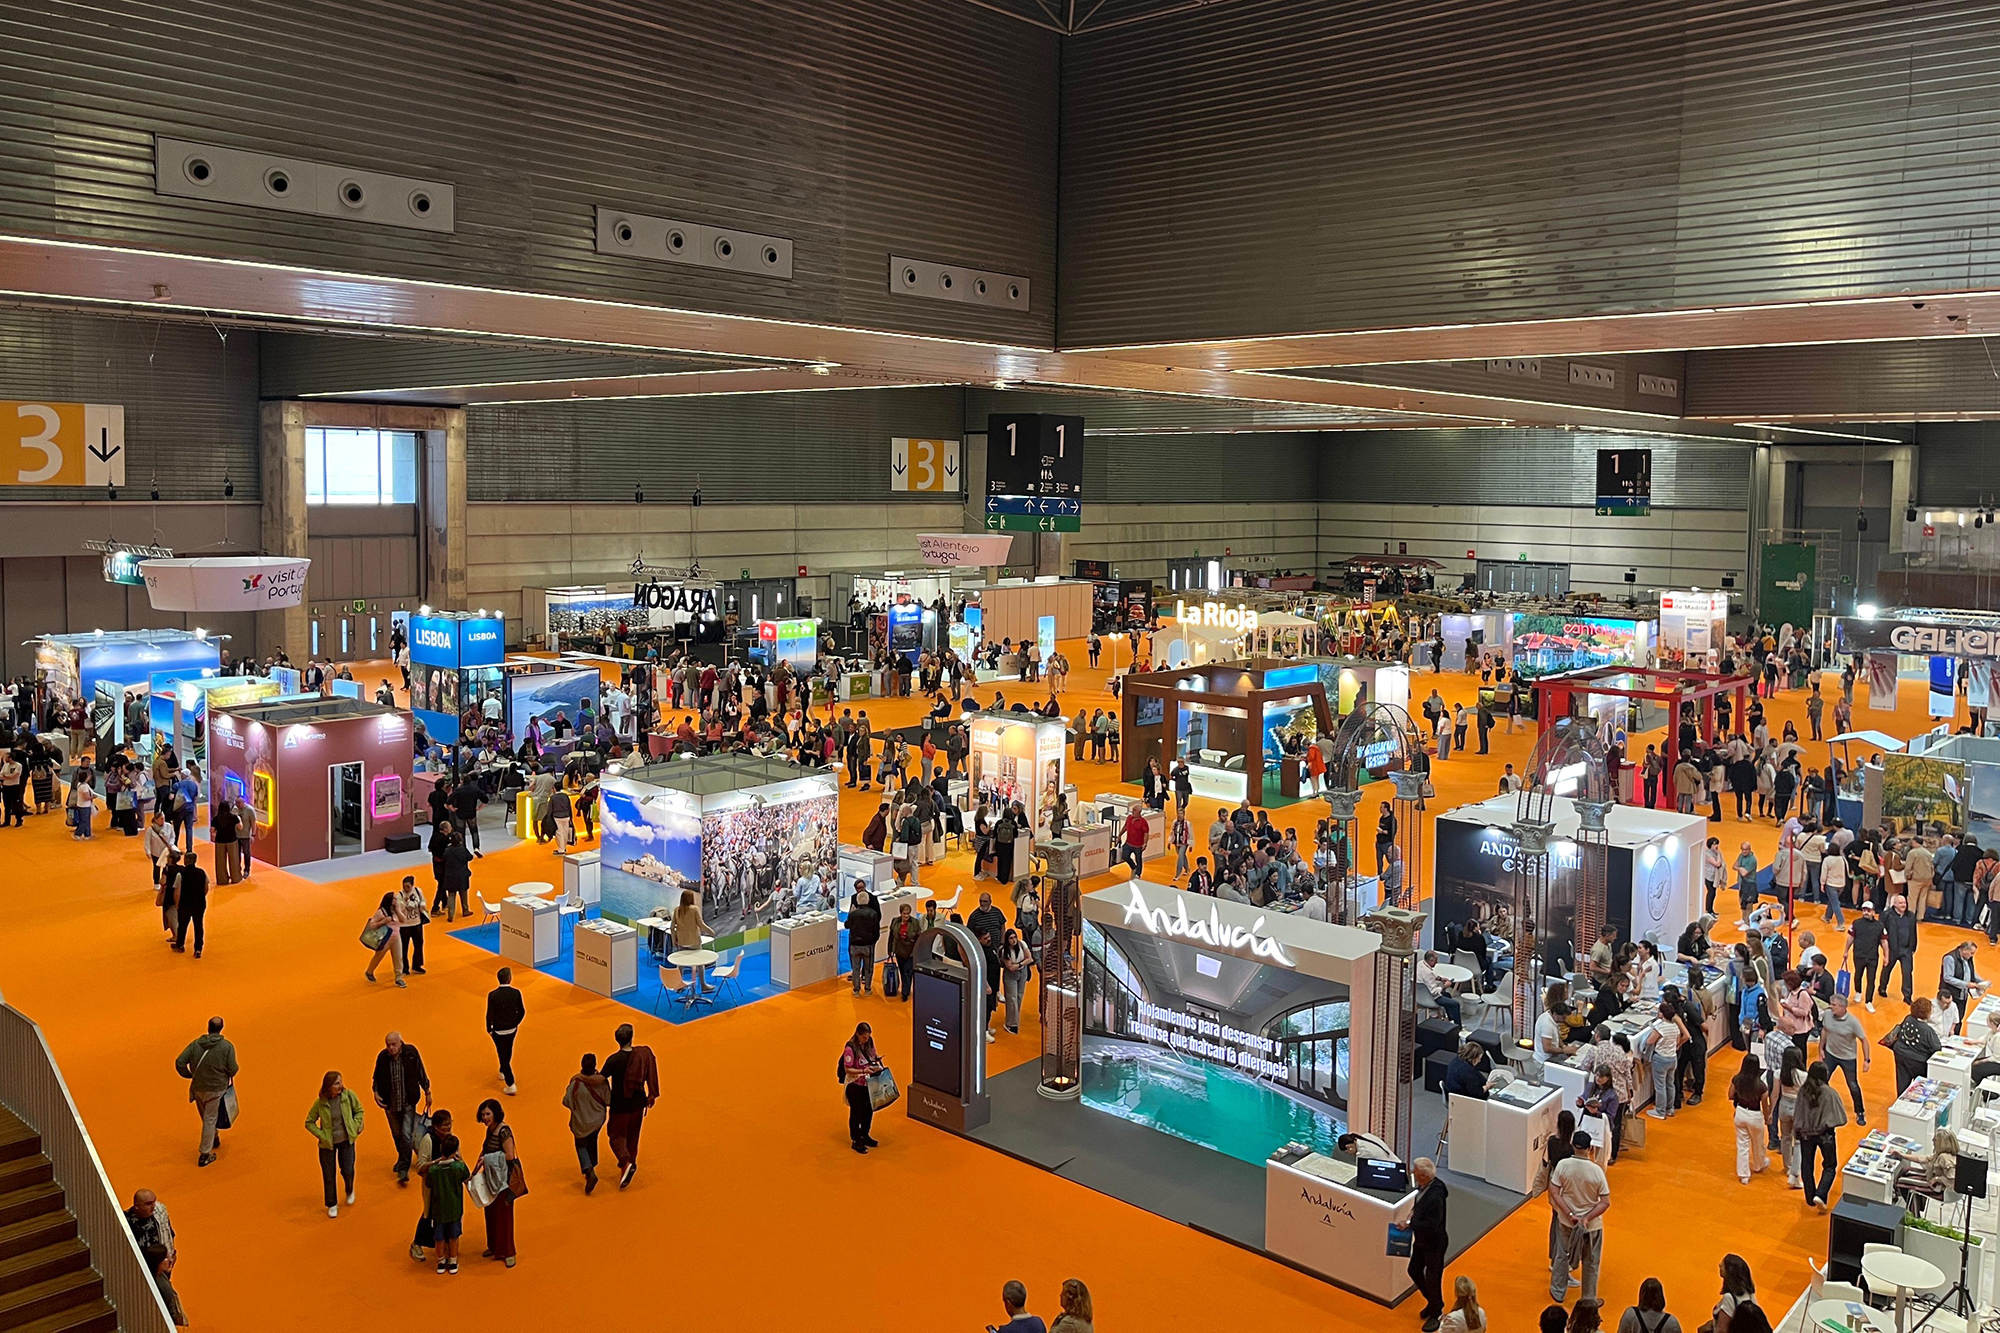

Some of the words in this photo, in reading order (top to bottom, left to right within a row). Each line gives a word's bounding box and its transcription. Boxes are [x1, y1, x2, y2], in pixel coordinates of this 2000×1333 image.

[18, 404, 63, 483] 3
[1006, 423, 1016, 456] 1
[1056, 425, 1065, 458] 1
[917, 441, 936, 490] 3
[1611, 454, 1619, 474] 1
[990, 481, 996, 491] 3
[1040, 482, 1045, 492] 2
[1056, 483, 1060, 493] 3
[933, 540, 979, 553] Alentejo
[104, 557, 143, 580] Algarve
[268, 569, 296, 584] visit
[1177, 600, 1200, 625] La
[1204, 602, 1258, 632] Rioja
[416, 628, 451, 649] LISBOA
[469, 632, 497, 641] LISBOA
[1890, 626, 2000, 655] GALICI
[1122, 880, 1297, 967] Andalucía
[806, 943, 834, 957] CASTELLÓN
[1138, 1000, 1197, 1031] Alojamientos
[1198, 1017, 1220, 1038] para
[1221, 1024, 1274, 1053] descansar
[1274, 1040, 1283, 1056] y
[1130, 1020, 1169, 1042] reunirse
[1170, 1032, 1188, 1051] que
[1189, 1036, 1227, 1061] marcan
[1238, 1052, 1289, 1079] diferencia
[1301, 1187, 1356, 1221] Andalucía
